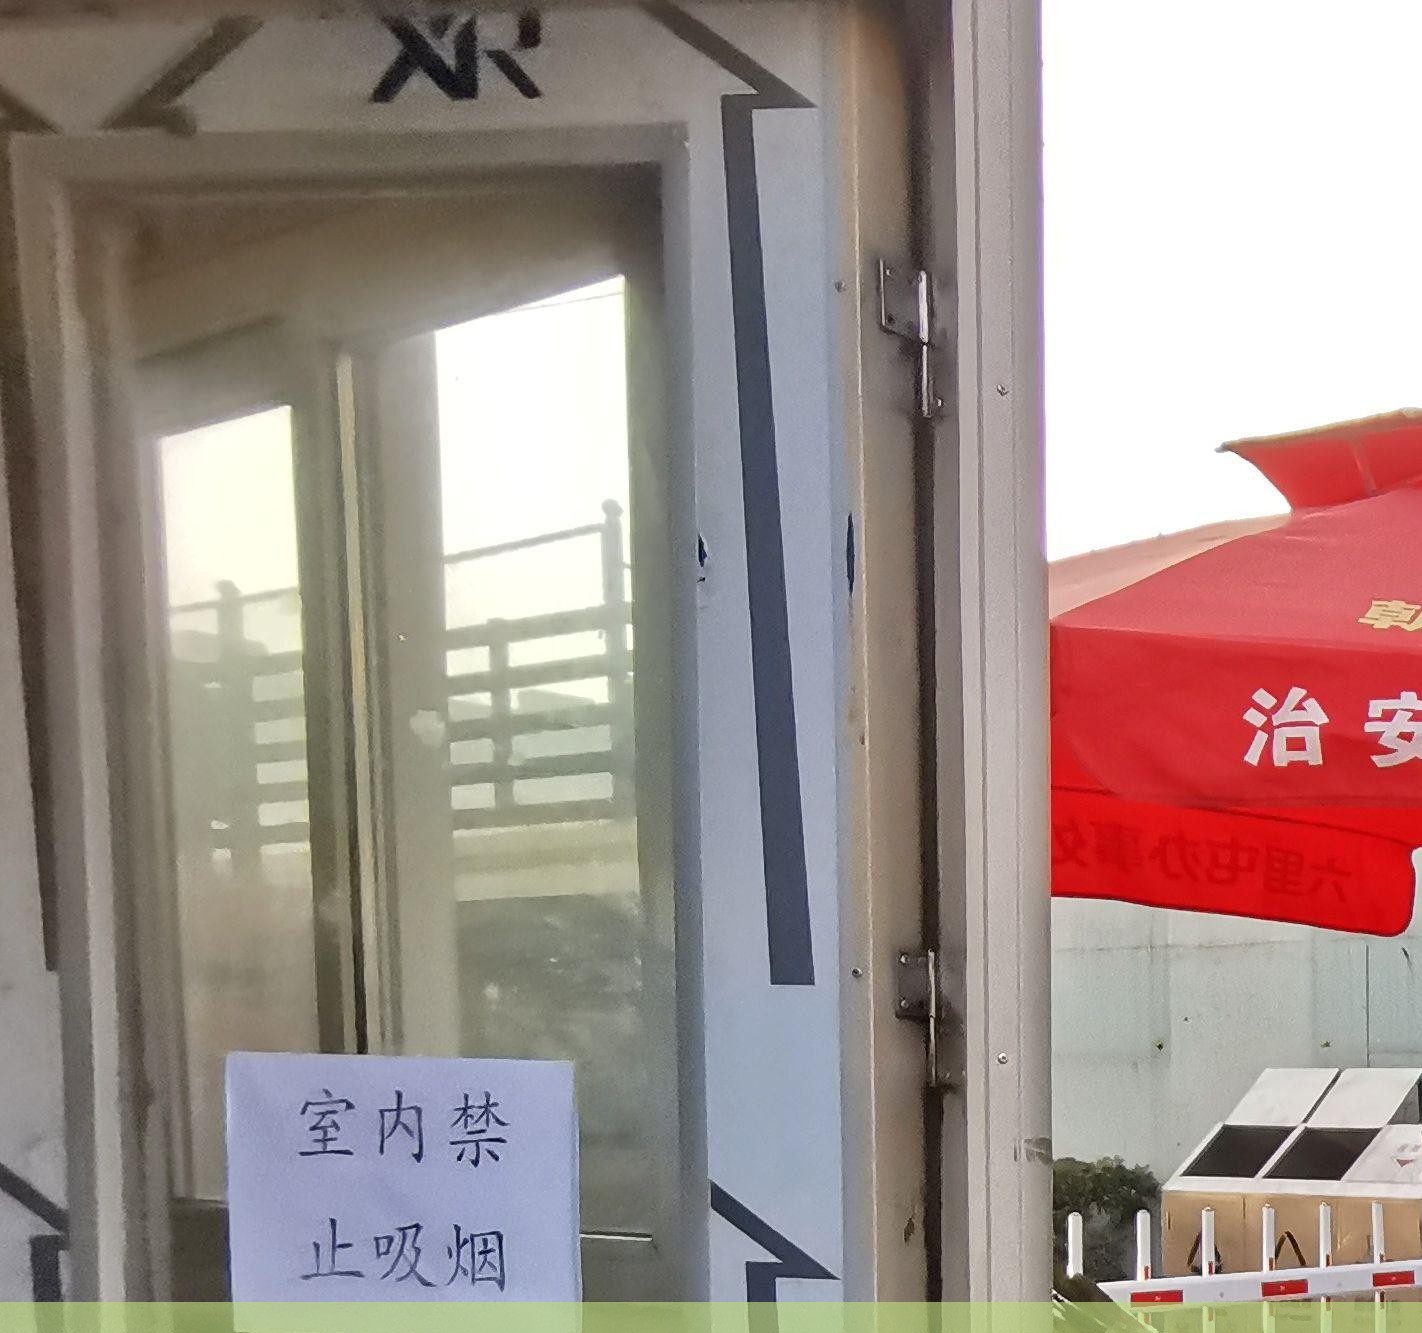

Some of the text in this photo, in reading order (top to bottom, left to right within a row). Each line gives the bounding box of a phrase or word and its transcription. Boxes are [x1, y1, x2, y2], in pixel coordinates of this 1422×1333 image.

[298, 1088, 510, 1168] 室内禁
[299, 1217, 506, 1292] 止吸烟
